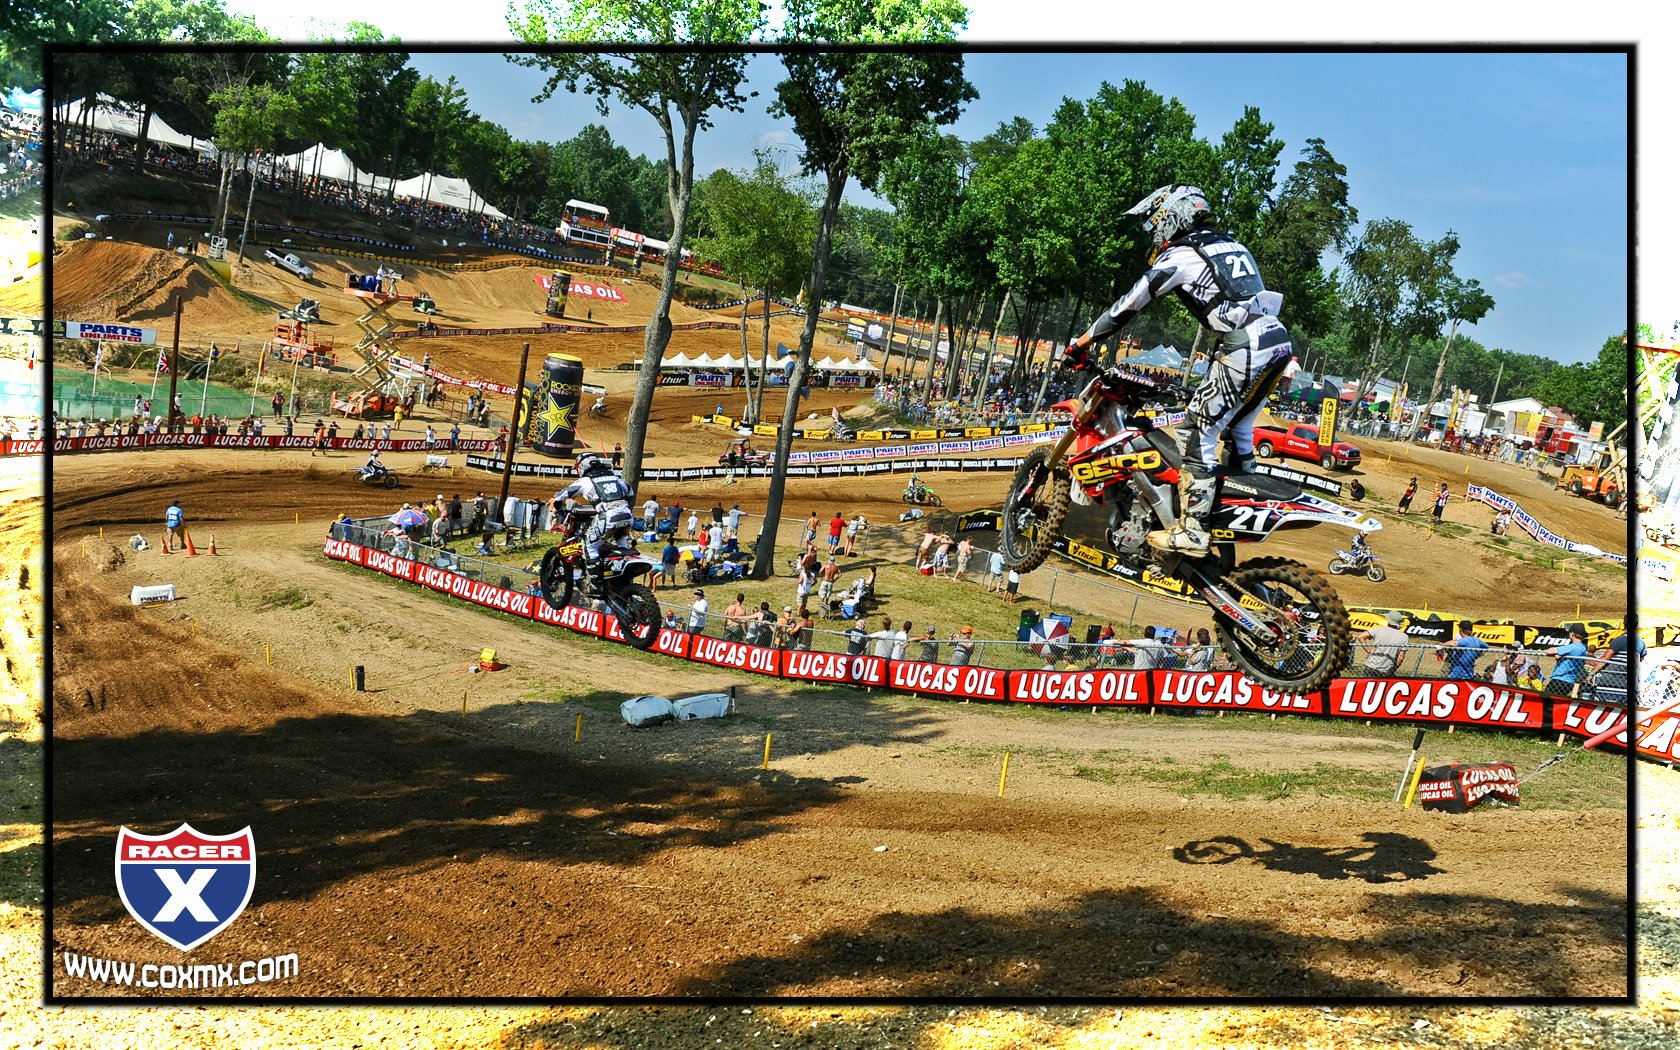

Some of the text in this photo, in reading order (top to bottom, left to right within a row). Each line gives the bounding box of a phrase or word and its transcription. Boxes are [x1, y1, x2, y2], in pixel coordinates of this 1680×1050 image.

[1225, 254, 1256, 279] 21
[596, 286, 621, 300] OIL
[80, 323, 143, 337] PARTS
[80, 333, 142, 342] UNLIMITED
[662, 376, 685, 384] thor
[487, 383, 499, 392] OIL
[501, 386, 517, 395] LUC
[82, 436, 139, 449] LUCAS OIL
[149, 434, 205, 445] LUCAS OIL
[214, 436, 270, 447] LUCAS OIL
[279, 436, 314, 447] LUCAS
[973, 438, 1001, 446] PARTS
[1005, 433, 1034, 442] PARTS
[10, 440, 73, 454] LUCA OIL
[342, 438, 393, 450] LUCAS OIL
[401, 440, 427, 450] LUCA
[459, 440, 486, 450] LUCAS
[517, 464, 532, 472] MILK
[534, 466, 554, 474] MUSCLE
[715, 466, 750, 475] MUSCLE MILK
[787, 466, 820, 475] MUSCLE MILK
[841, 465, 855, 473] MILK
[857, 463, 890, 472] MUSCLE MILK
[893, 461, 912, 469] MUSCLE
[1072, 451, 1161, 481] GEICO
[681, 469, 699, 477] MUSCLE
[1270, 467, 1306, 482] MUSCLE MILK
[602, 482, 618, 494] 38
[1223, 480, 1258, 495] HONDA
[1306, 475, 1341, 492] MUSCLE MILK
[1485, 490, 1515, 510] PARTS
[966, 521, 991, 529] thor
[1228, 506, 1271, 532] 21
[1516, 508, 1538, 530] PARTS
[1540, 528, 1564, 547] PARTS
[349, 543, 361, 562] OIL
[1078, 550, 1097, 561] thor
[367, 550, 411, 578] LUCAS OIL
[611, 560, 623, 571] 38
[1112, 564, 1138, 576] thor
[418, 566, 471, 597] LUCAS OIL
[471, 583, 529, 614] LUCAS OIL
[538, 601, 577, 626] LUCAS
[577, 610, 599, 632] OIL
[1219, 602, 1256, 630] AMSOIL
[1406, 625, 1444, 636] thor
[659, 631, 683, 654] OIL
[695, 638, 775, 671] LUCAS OIL
[787, 652, 880, 683] LUCAS OIL
[894, 663, 997, 696] LUCAS OIL
[1016, 672, 1139, 701] LUCAS OIL
[1160, 673, 1255, 706] LUCAS
[1339, 680, 1530, 723] LUCAS OIL
[1462, 768, 1516, 786] LUCAS OIL
[1419, 781, 1452, 791] LUCAS OIL
[1420, 790, 1454, 799] LUCAS OIL
